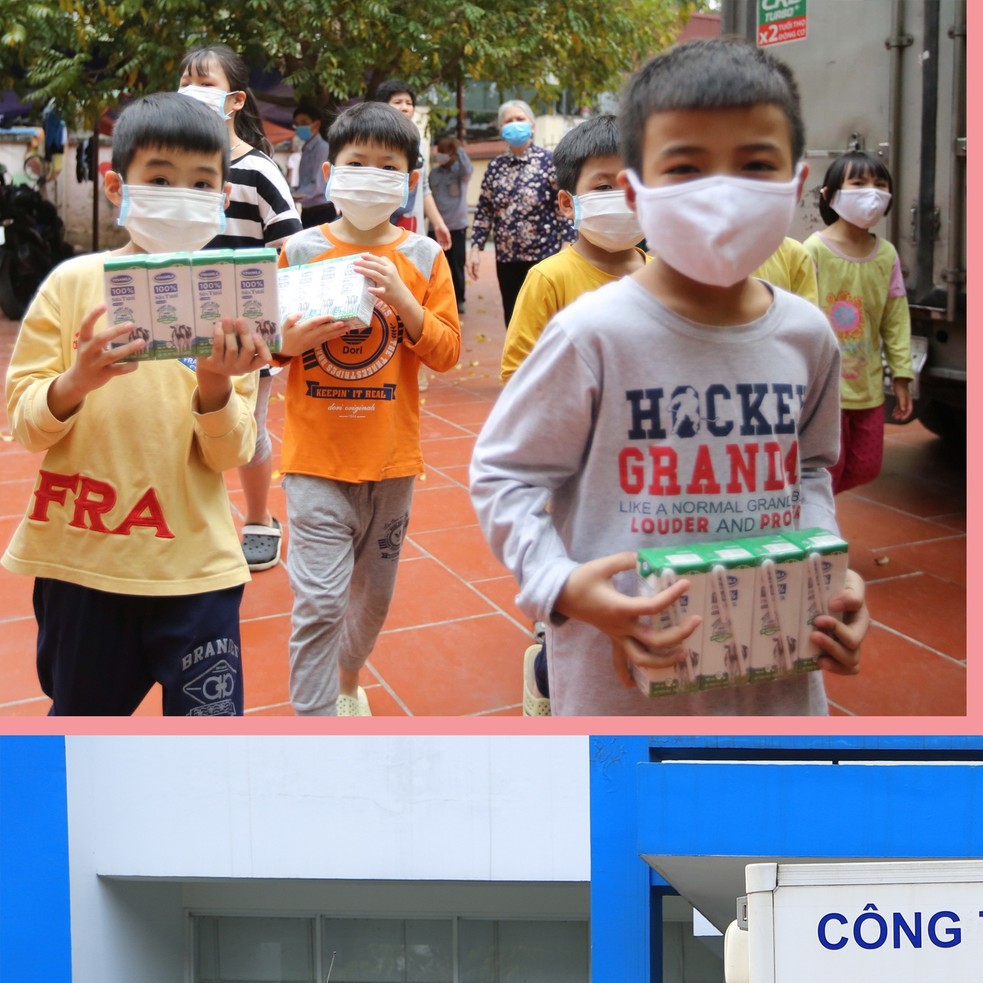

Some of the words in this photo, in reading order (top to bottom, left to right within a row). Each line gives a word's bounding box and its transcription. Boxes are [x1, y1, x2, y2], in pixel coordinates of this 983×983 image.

[759, 24, 779, 44] x2
[155, 284, 177, 292] 100%
[199, 282, 221, 290] 100%
[242, 280, 263, 288] 100%
[112, 287, 134, 295] 100%
[353, 389, 363, 398] IT
[365, 390, 386, 399] REAL
[28, 469, 175, 539] FRA
[620, 501, 654, 515] LIKE
[656, 503, 668, 515] A
[672, 501, 743, 515] NORMAL
[631, 516, 709, 535] LOUDER
[716, 517, 755, 533] AND
[817, 902, 962, 951] CÔNG
